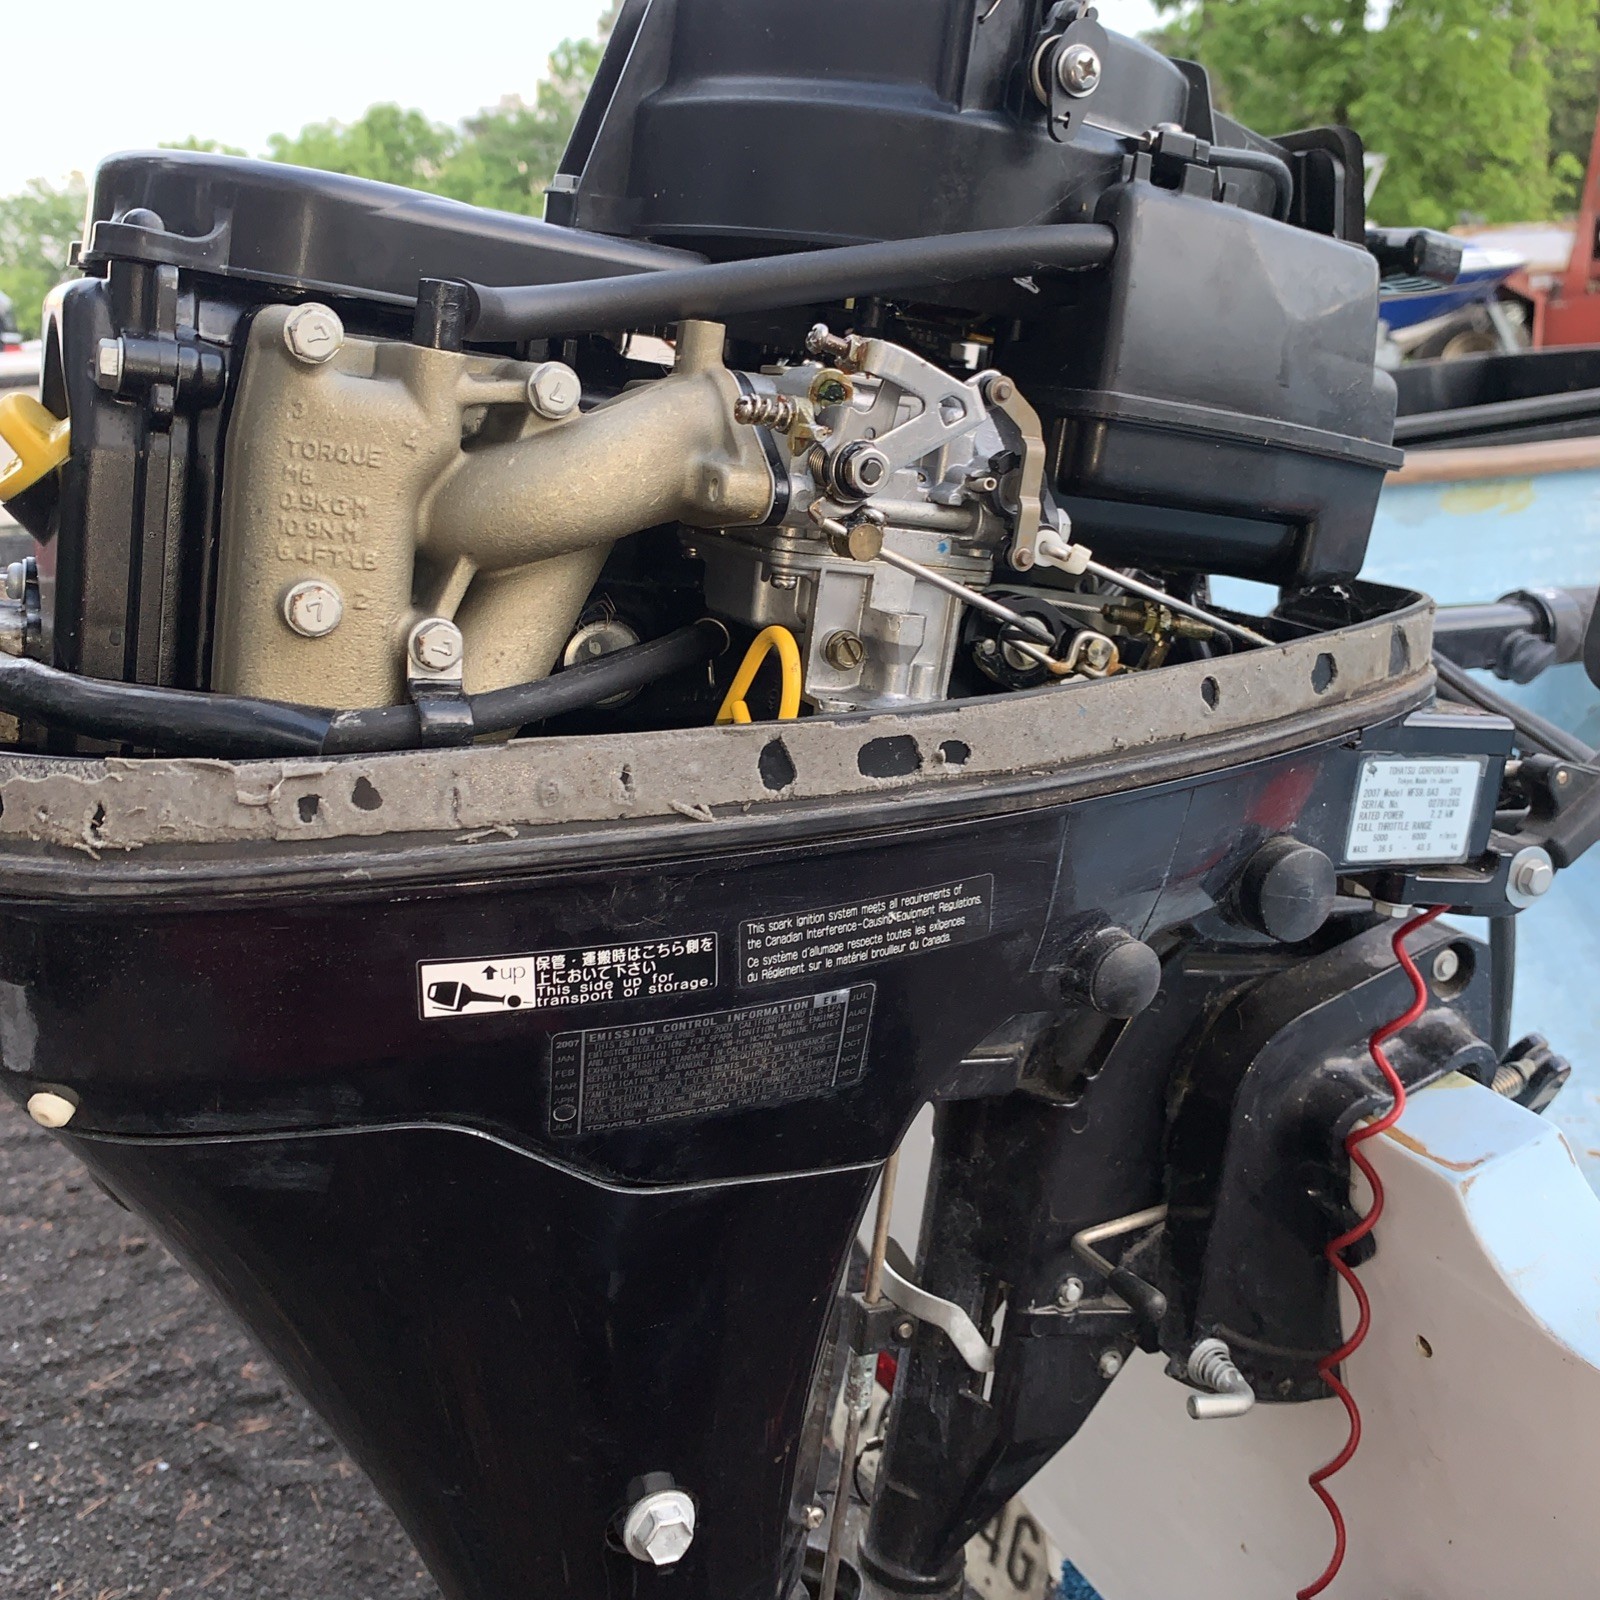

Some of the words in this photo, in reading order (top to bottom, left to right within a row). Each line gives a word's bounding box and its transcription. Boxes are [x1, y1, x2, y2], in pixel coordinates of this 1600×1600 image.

[284, 438, 383, 469] TORQUE
[1389, 767, 1416, 775] TOHATSU
[1364, 789, 1380, 798] 2007
[1384, 788, 1403, 797] Model
[1361, 800, 1385, 809] SERIAL
[1359, 812, 1380, 820] RATED
[1383, 811, 1404, 820] POWER
[1357, 823, 1373, 831] FULL
[1378, 822, 1409, 831] THROTTLE
[1412, 821, 1433, 830] RANGE
[1373, 834, 1388, 842] 5000
[747, 922, 765, 935] This
[769, 919, 793, 932] spark
[796, 913, 825, 927] ignition
[828, 907, 858, 922] system
[861, 901, 886, 915] meets
[889, 898, 898, 910] all
[901, 887, 951, 907] requirements
[953, 883, 963, 896] of
[747, 938, 762, 950] the
[765, 931, 803, 947] Canadian
[806, 911, 893, 940] Interference-Causing
[896, 904, 935, 922] Equipment
[938, 895, 983, 913] Regulations.
[747, 956, 760, 969] Ce
[762, 950, 798, 967] système
[801, 942, 844, 959] d'allumage
[847, 933, 883, 950] respecte
[886, 928, 912, 943] toutes
[914, 925, 926, 936] les
[929, 916, 966, 933] exigences
[747, 972, 759, 983] du
[808, 960, 822, 972] sur
[825, 957, 833, 968] le
[836, 950, 869, 967] matériel
[871, 943, 906, 959] brouilleur
[909, 940, 919, 951] du
[500, 965, 526, 984] up
[536, 961, 657, 987] 上において下さい
[536, 984, 571, 997] This
[580, 980, 614, 993] side
[623, 977, 642, 989] up
[652, 972, 674, 984] for
[537, 989, 614, 1008] transport
[623, 987, 640, 998] or
[648, 977, 713, 994] storage.
[851, 991, 867, 1001] JUL
[848, 1007, 866, 1017] AUG
[589, 1025, 654, 1042] EMISSION
[662, 1016, 717, 1033] CONTROL
[727, 1000, 808, 1022] INFORMATION
[846, 1023, 863, 1033] SEP
[594, 1041, 614, 1050] THIS
[619, 1037, 649, 1047] ENGINE
[700, 1026, 710, 1035] TO
[713, 1023, 734, 1033] 2007
[738, 1014, 786, 1029] CALIFORNIA
[790, 1010, 805, 1019] AND
[632, 1038, 686, 1054] REGULATIONS
[690, 1035, 705, 1045] FOR
[709, 1031, 733, 1042] SPARK
[738, 1024, 774, 1037] IGNITION
[777, 1018, 804, 1030] MARINE
[809, 1010, 840, 1023] ENGINES
[555, 1038, 579, 1049] 2007
[588, 1058, 603, 1067] AND
[608, 1056, 618, 1064] IS
[622, 1050, 666, 1062] CERTIFIED
[672, 1047, 681, 1055] TO
[812, 1018, 839, 1030] FAMILY
[843, 1038, 860, 1048] OCT
[555, 1054, 574, 1063] JAN
[626, 1057, 666, 1070] EMISSION
[670, 1050, 708, 1063] STANDARD
[713, 1048, 723, 1056] IN
[841, 1052, 859, 1062] NOV
[586, 1073, 613, 1083] REFER
[619, 1070, 629, 1078] TO
[710, 1055, 725, 1064] FOR
[729, 1047, 769, 1061] REQUIRED
[664, 1071, 679, 1080] AND
[684, 1061, 739, 1077] ADJUSTMENTS
[838, 1068, 855, 1077] DEC
[555, 1068, 574, 1078] FEB
[554, 1081, 577, 1091] MAR
[553, 1095, 574, 1105] APR
[584, 1117, 641, 1132] TOHATSU
[645, 1102, 729, 1122] CORPORATION
